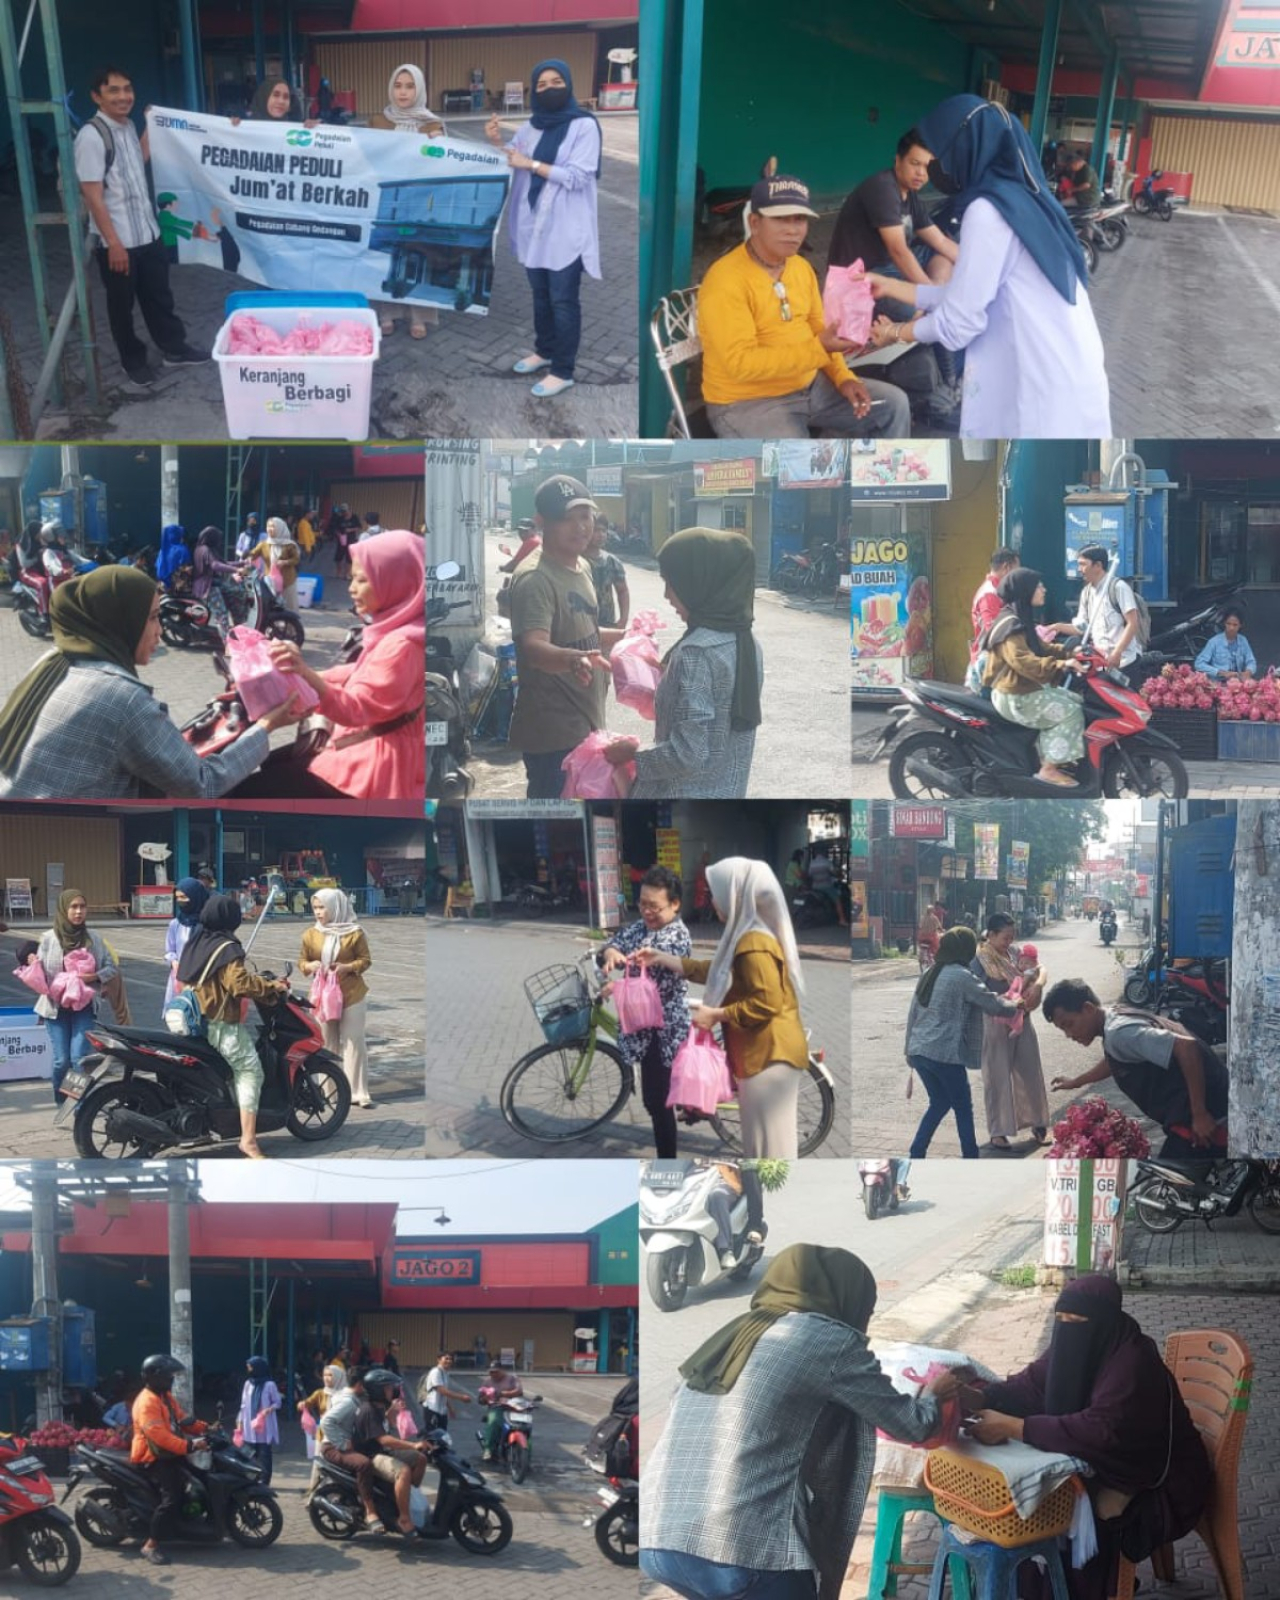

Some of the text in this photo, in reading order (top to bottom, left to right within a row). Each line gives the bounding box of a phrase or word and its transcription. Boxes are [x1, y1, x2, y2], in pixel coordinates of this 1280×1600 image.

[202, 145, 343, 179] PEGADAIAN PEDULI
[447, 149, 499, 166] Pegadaian
[301, 182, 369, 209] Berkah
[240, 366, 305, 387] Keranjang
[285, 384, 351, 403] Berbagi
[851, 539, 908, 564] JAGO
[864, 571, 895, 584] BUAH
[9, 1044, 46, 1055] Berbagi
[1097, 1179, 1116, 1192] GB
[400, 1261, 469, 1276] JAGO 2
